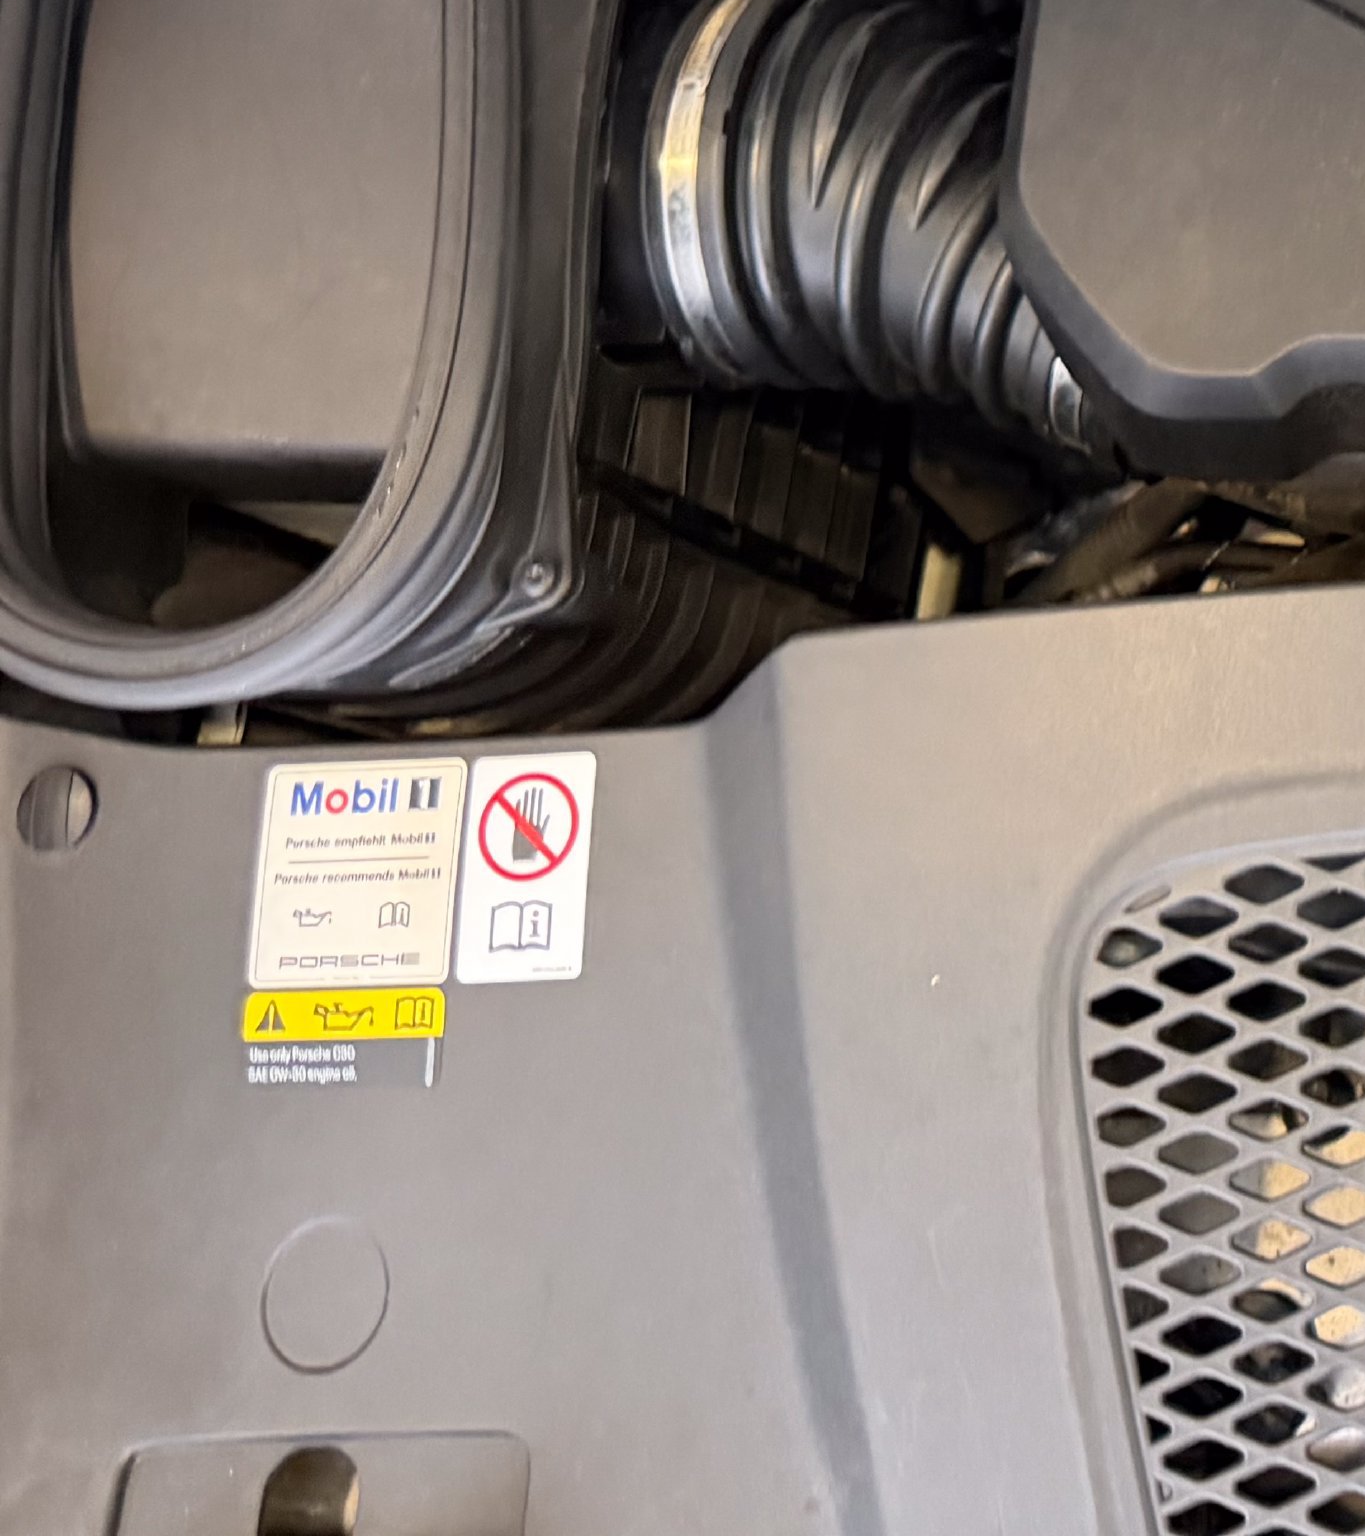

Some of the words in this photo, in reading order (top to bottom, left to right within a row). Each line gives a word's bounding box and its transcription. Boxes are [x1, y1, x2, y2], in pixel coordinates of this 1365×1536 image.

[290, 778, 399, 816] Mobil
[285, 837, 330, 850] Porsche
[334, 834, 386, 849] empfiehlt
[274, 873, 319, 886] Porsche
[322, 870, 394, 884] recommends
[279, 952, 420, 970] PORSCHE
[269, 1045, 291, 1066] only
[292, 1044, 331, 1063] Porsche
